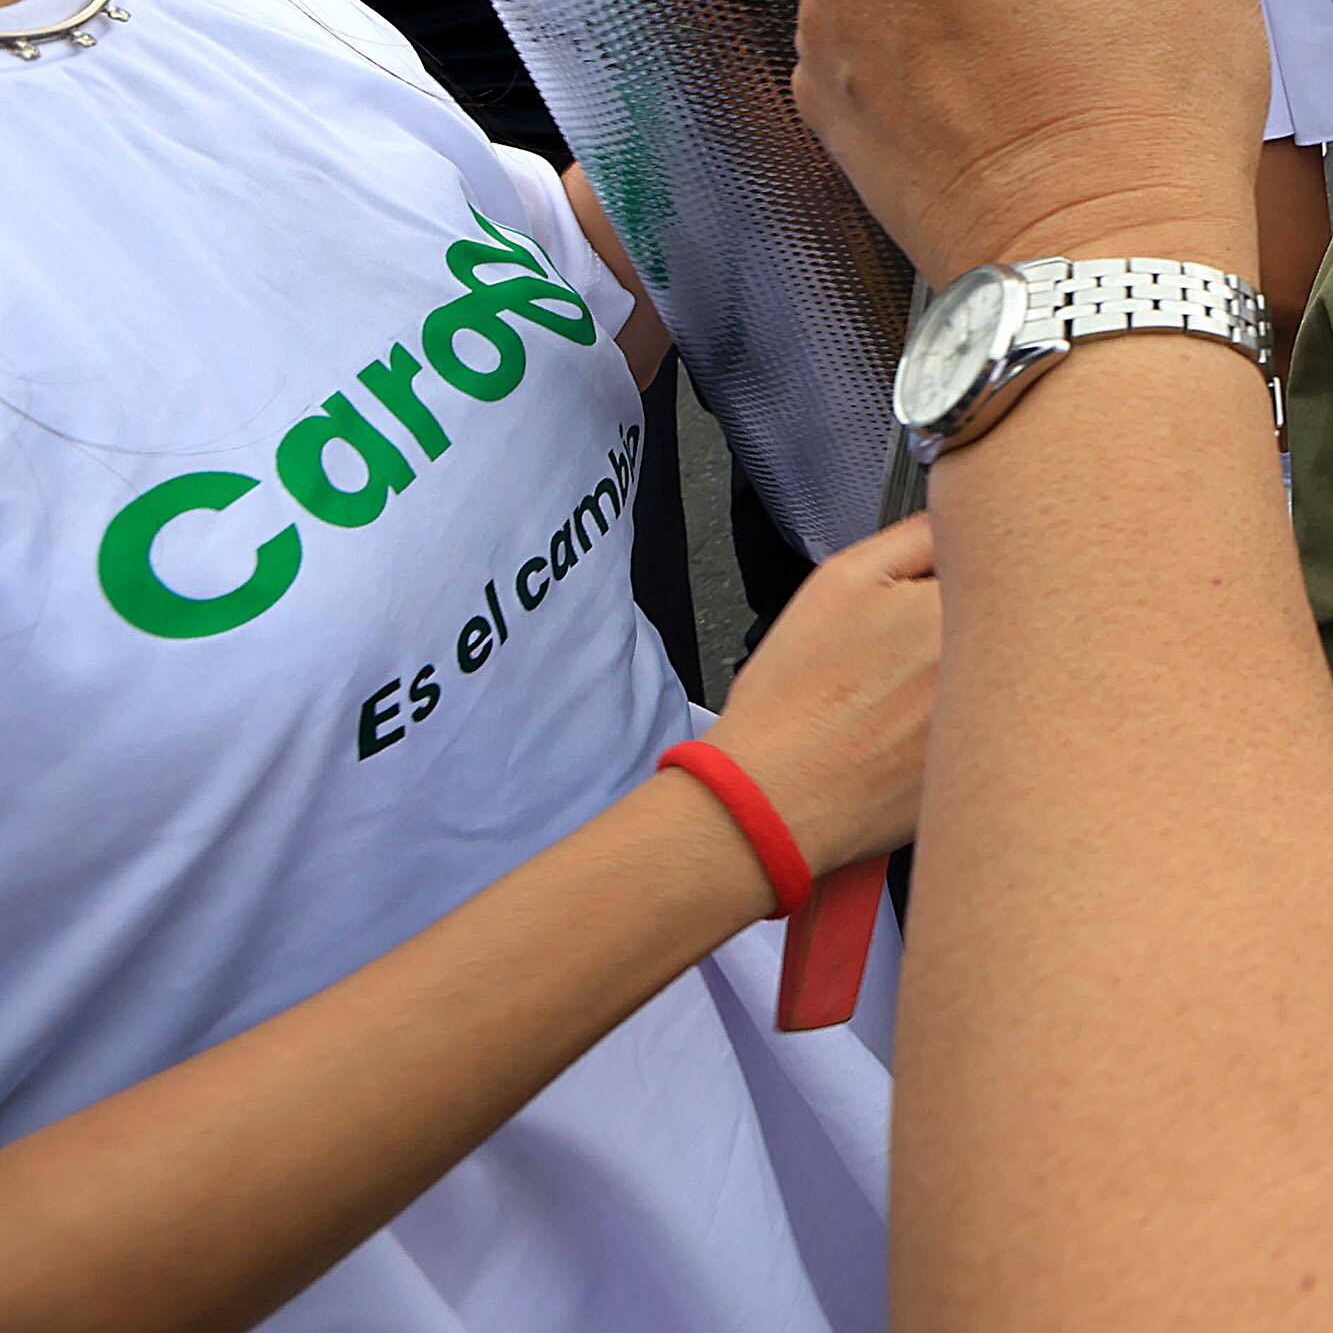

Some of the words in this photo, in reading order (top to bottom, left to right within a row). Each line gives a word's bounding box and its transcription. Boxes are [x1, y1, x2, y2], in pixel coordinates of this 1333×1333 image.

[98, 292, 528, 640] Caro
[358, 664, 441, 762] Es
[457, 579, 508, 674] el
[515, 423, 641, 612] cambio
